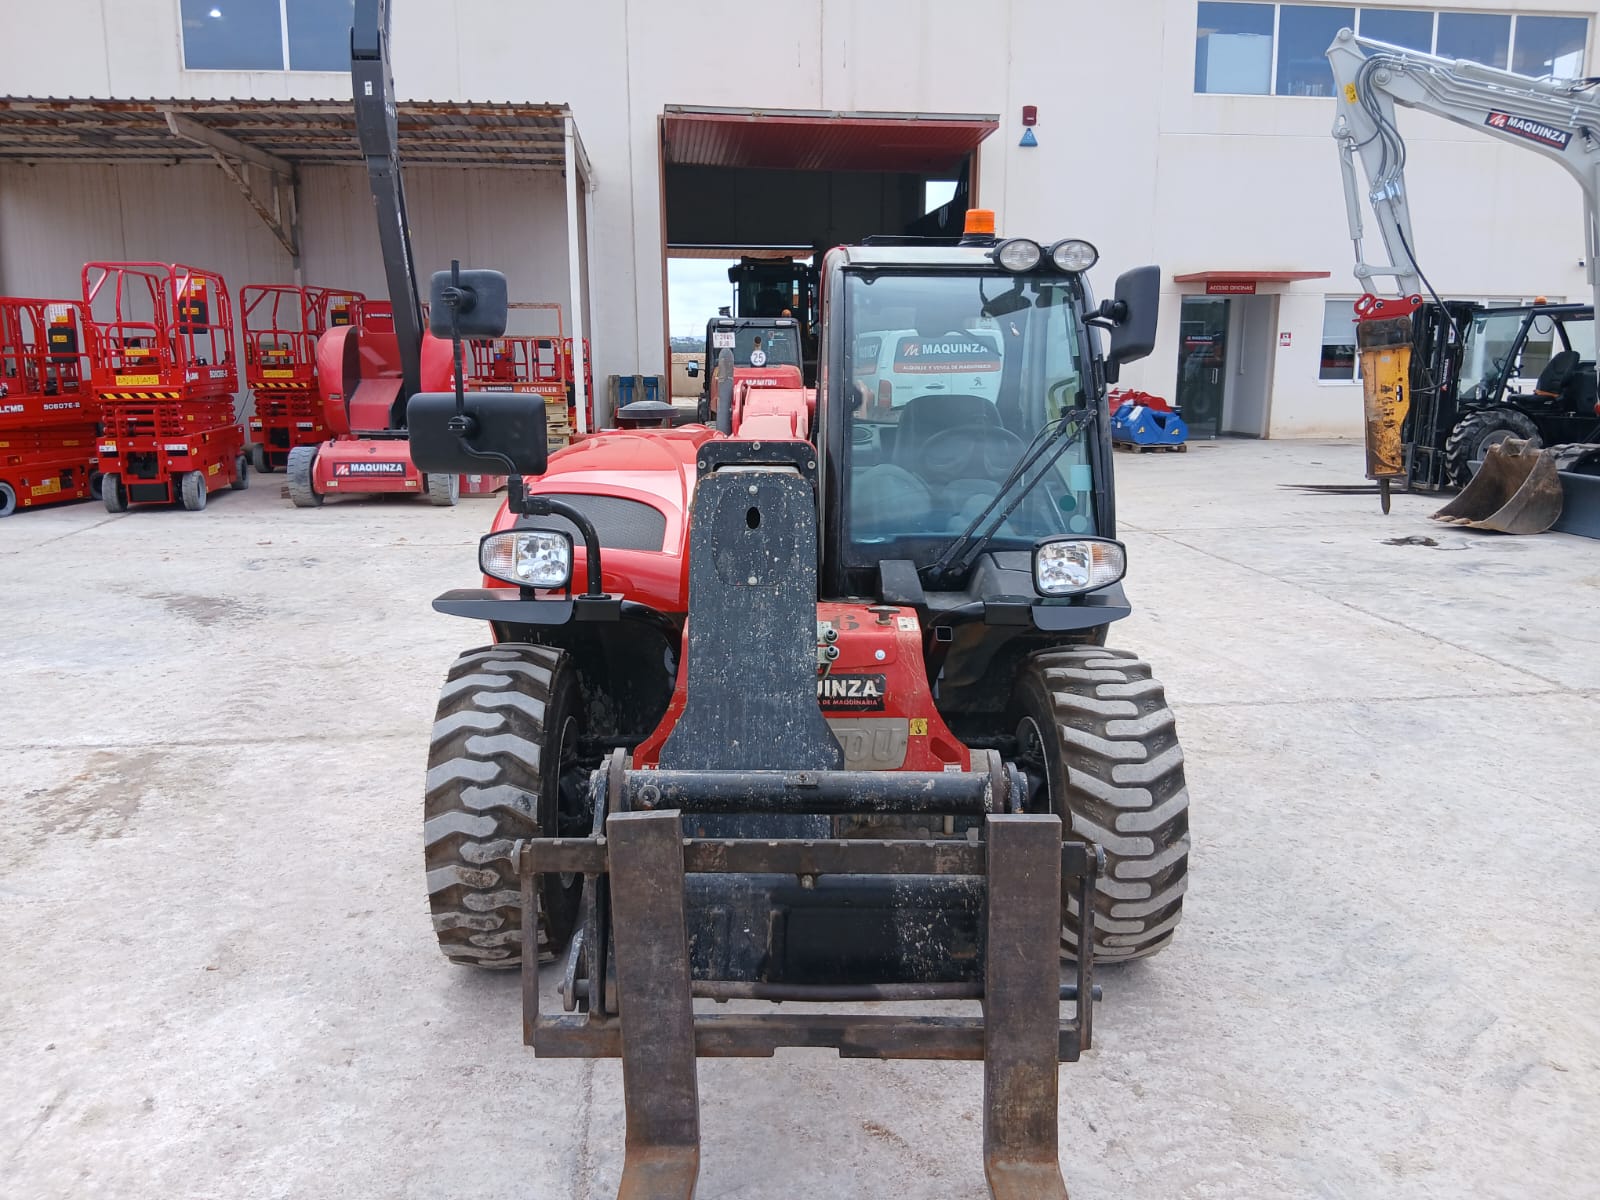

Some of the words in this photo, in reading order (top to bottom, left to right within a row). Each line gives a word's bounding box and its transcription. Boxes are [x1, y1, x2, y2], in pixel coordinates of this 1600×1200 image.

[1507, 117, 1566, 143] MAQUINZA
[922, 343, 988, 354] MAQUINZA
[753, 352, 764, 363] 25
[350, 463, 403, 472] MAQUINZA
